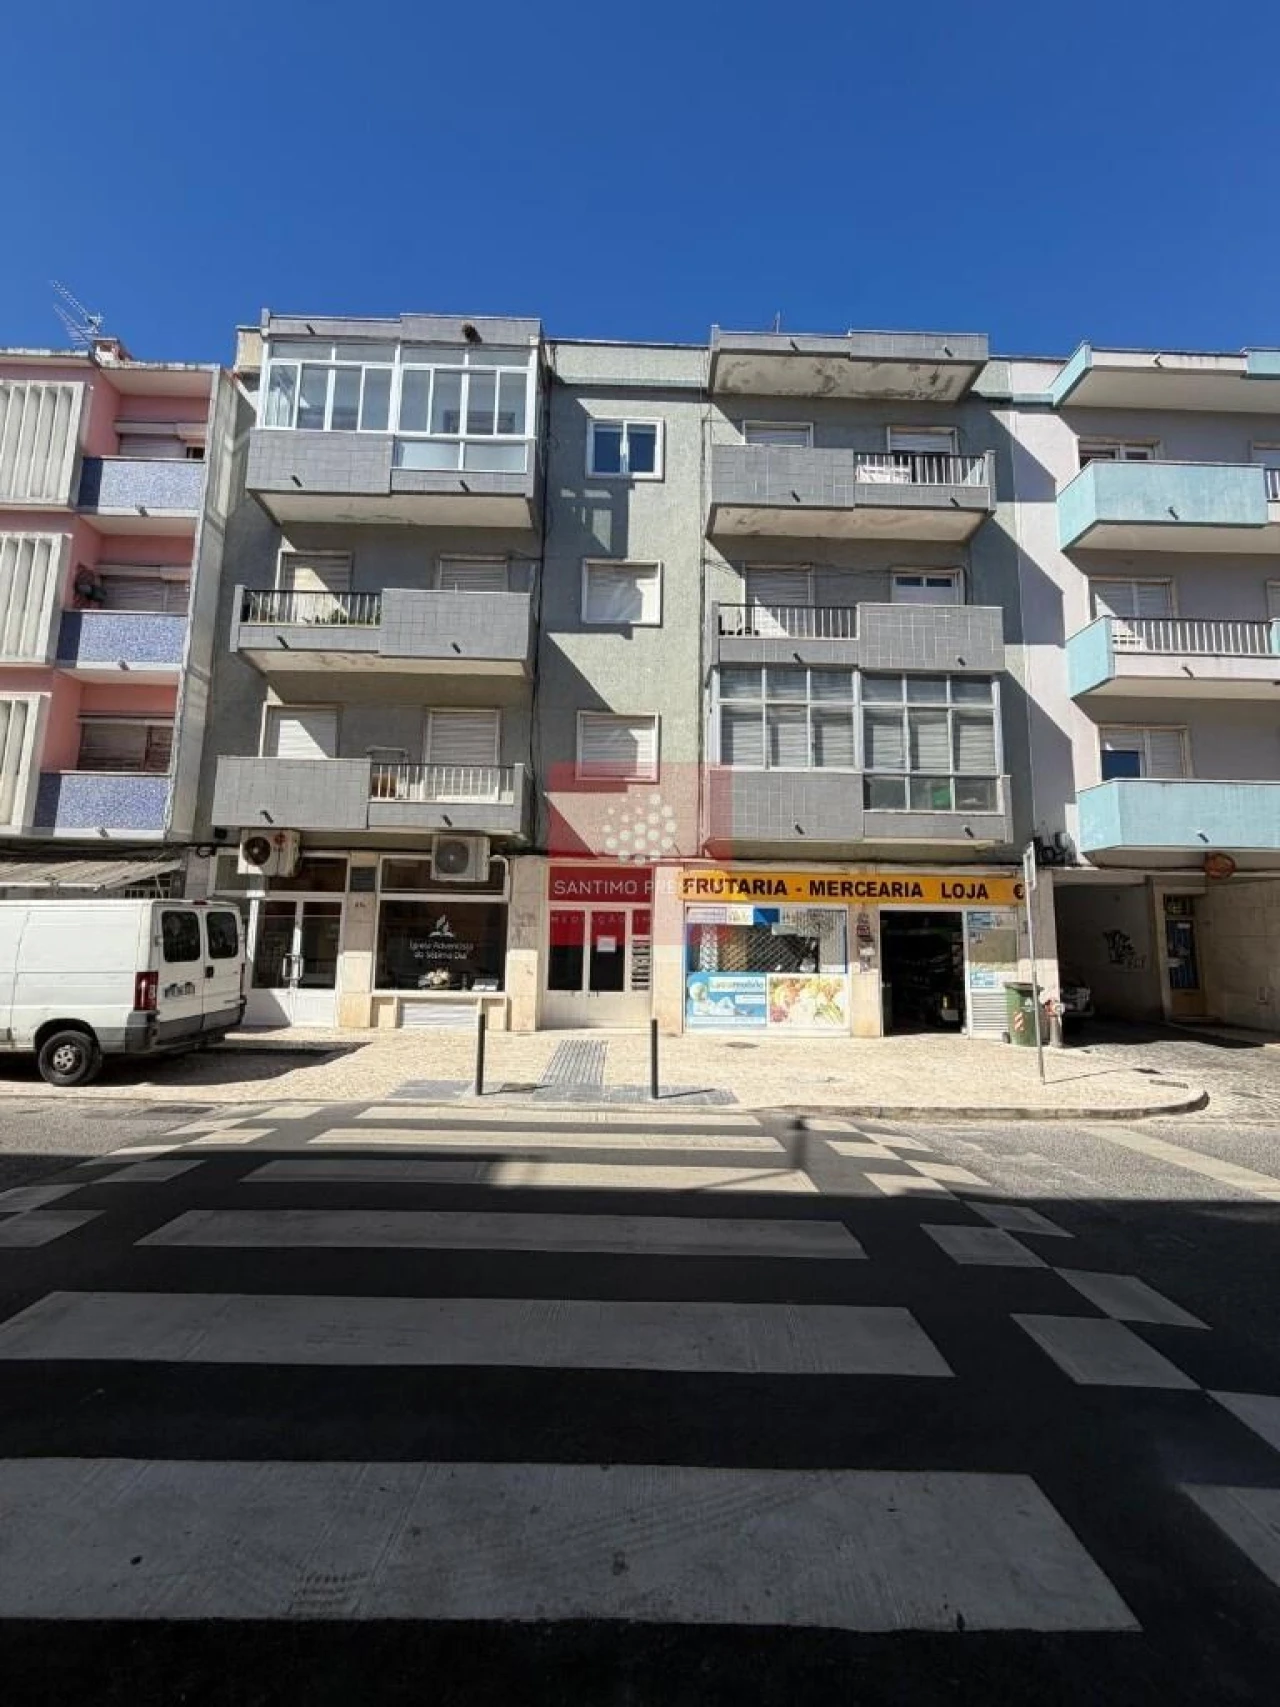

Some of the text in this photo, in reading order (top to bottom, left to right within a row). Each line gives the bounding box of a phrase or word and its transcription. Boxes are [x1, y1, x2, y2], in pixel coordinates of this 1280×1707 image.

[683, 877, 788, 896] FRUTARIA
[809, 880, 924, 898] MERCEARIA
[941, 881, 989, 900] LOJA
